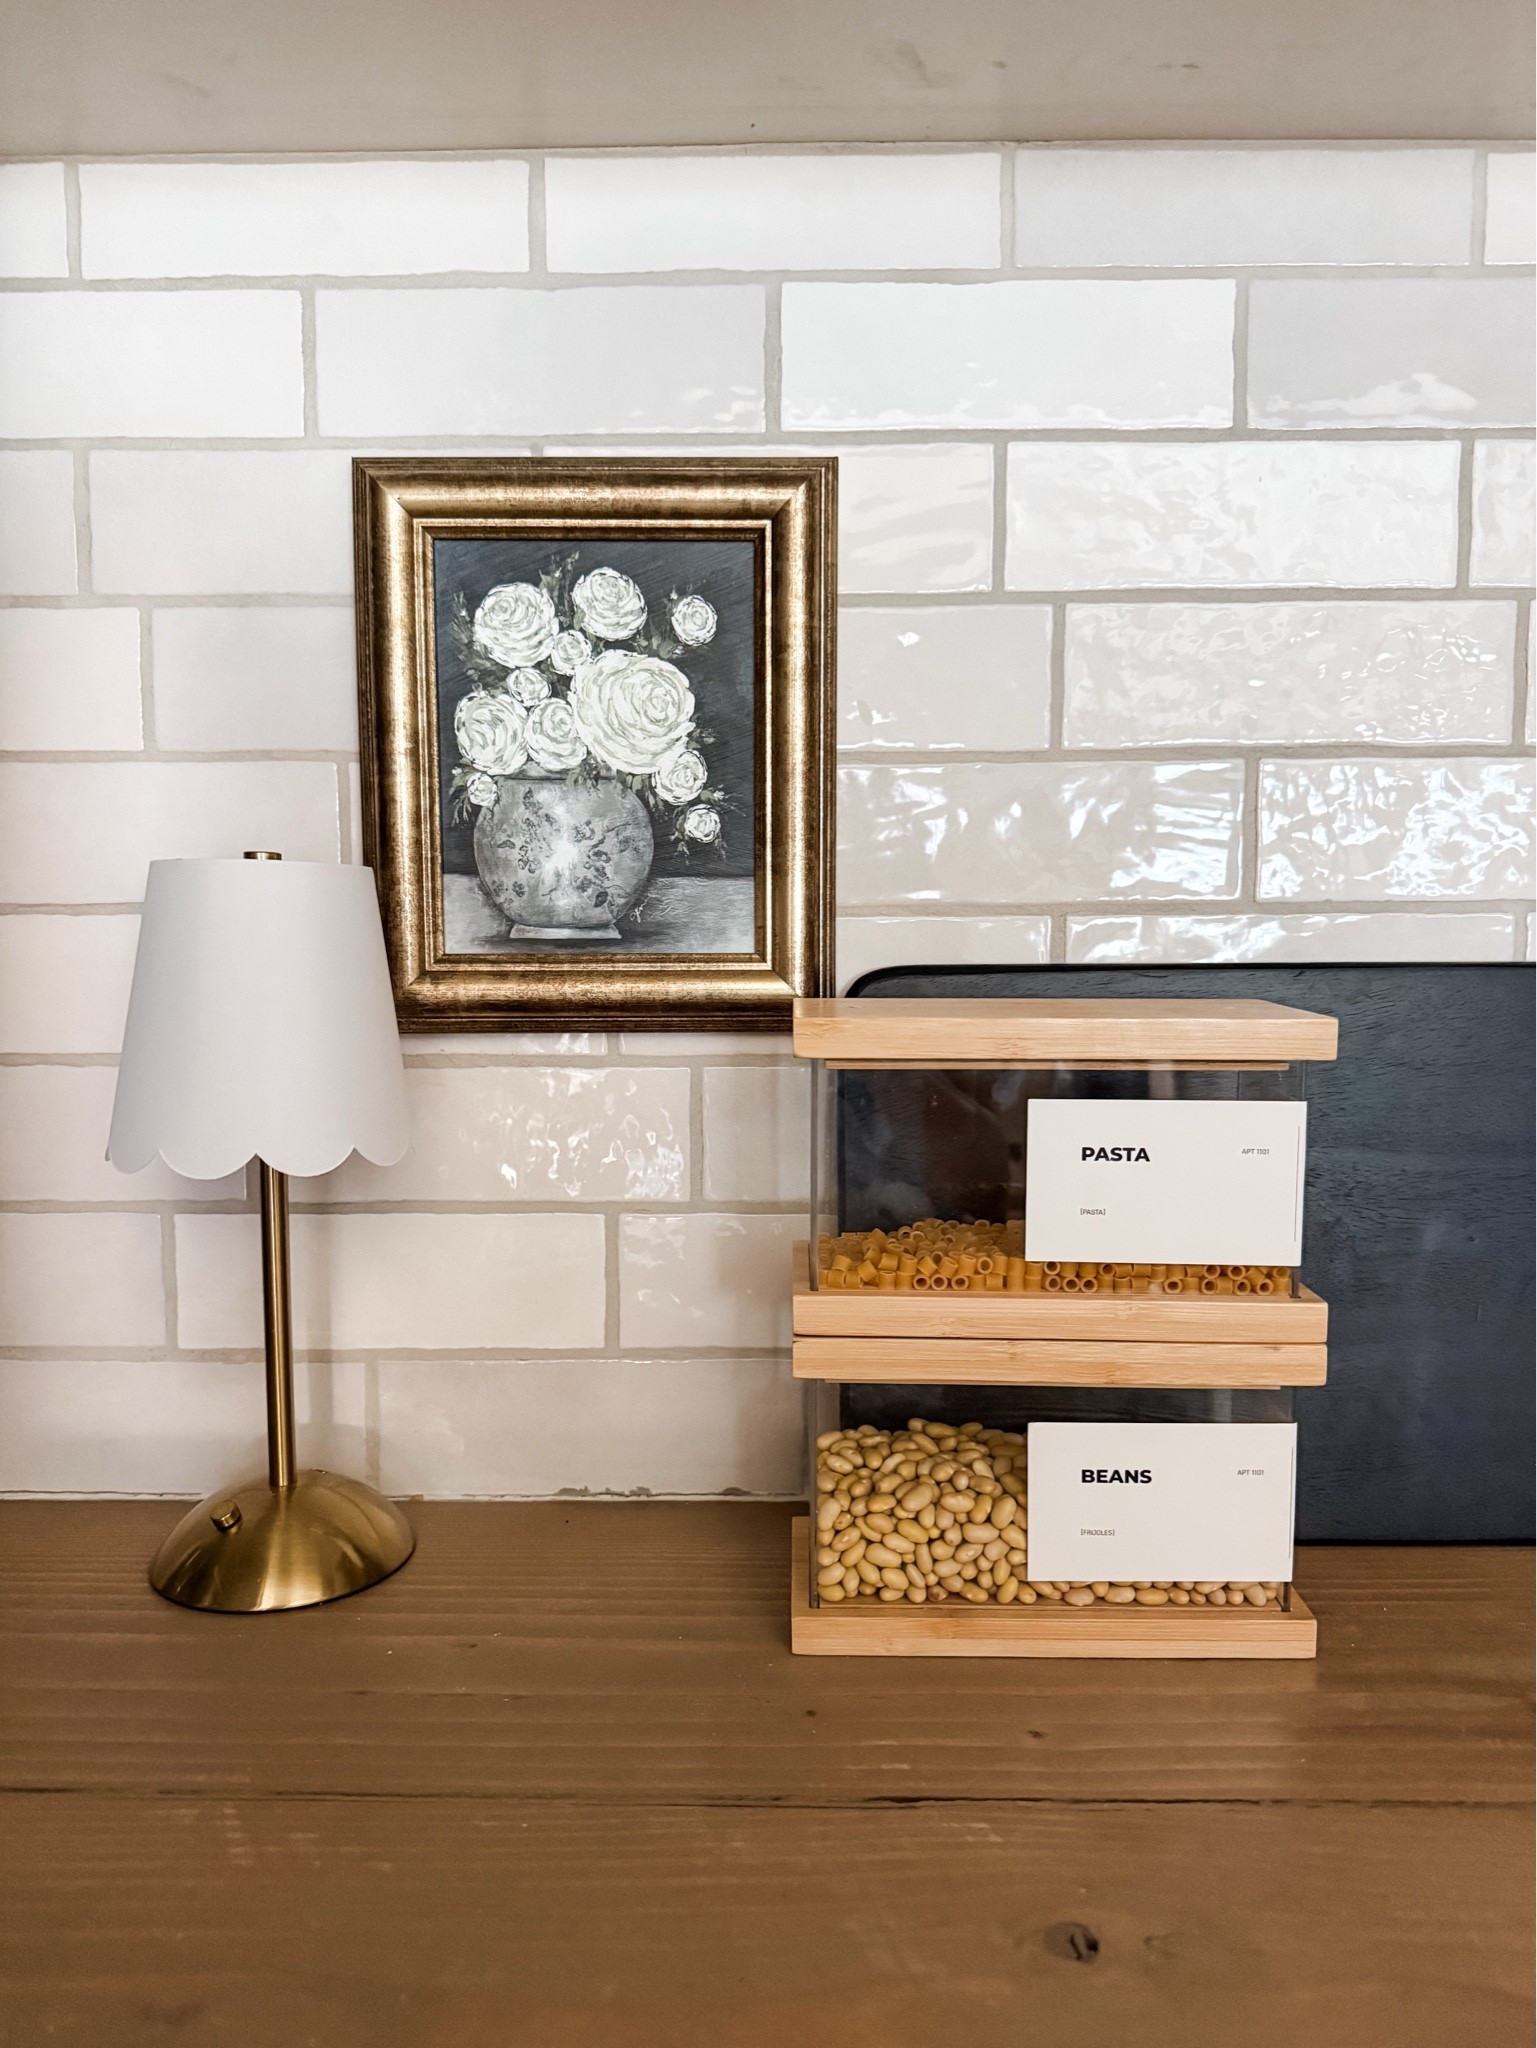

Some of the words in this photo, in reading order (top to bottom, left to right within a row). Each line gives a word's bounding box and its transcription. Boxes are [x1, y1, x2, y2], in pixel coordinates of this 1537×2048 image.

[1081, 1146, 1151, 1162] PASTA
[1080, 1207, 1106, 1216] [PASTA]
[1081, 1469, 1152, 1484] BEANS
